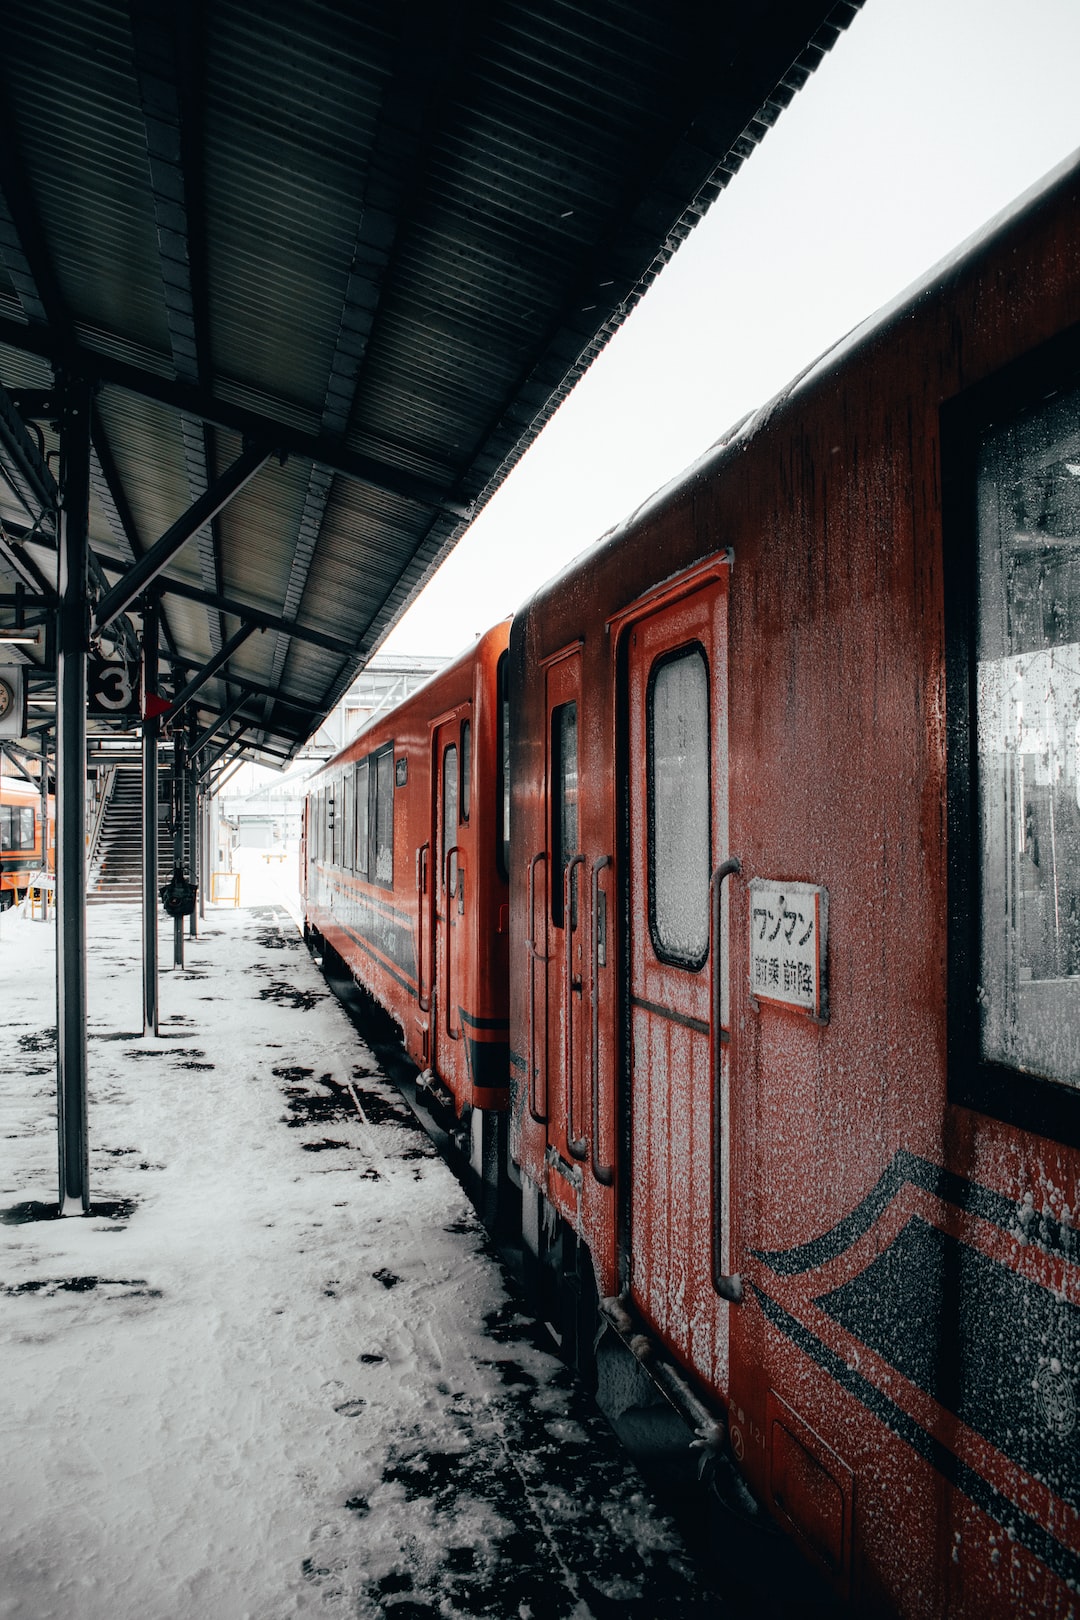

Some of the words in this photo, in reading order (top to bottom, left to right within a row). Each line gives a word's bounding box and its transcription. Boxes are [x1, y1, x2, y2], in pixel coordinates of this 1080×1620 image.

[94, 666, 133, 711] 3
[753, 908, 814, 946] ワンマン
